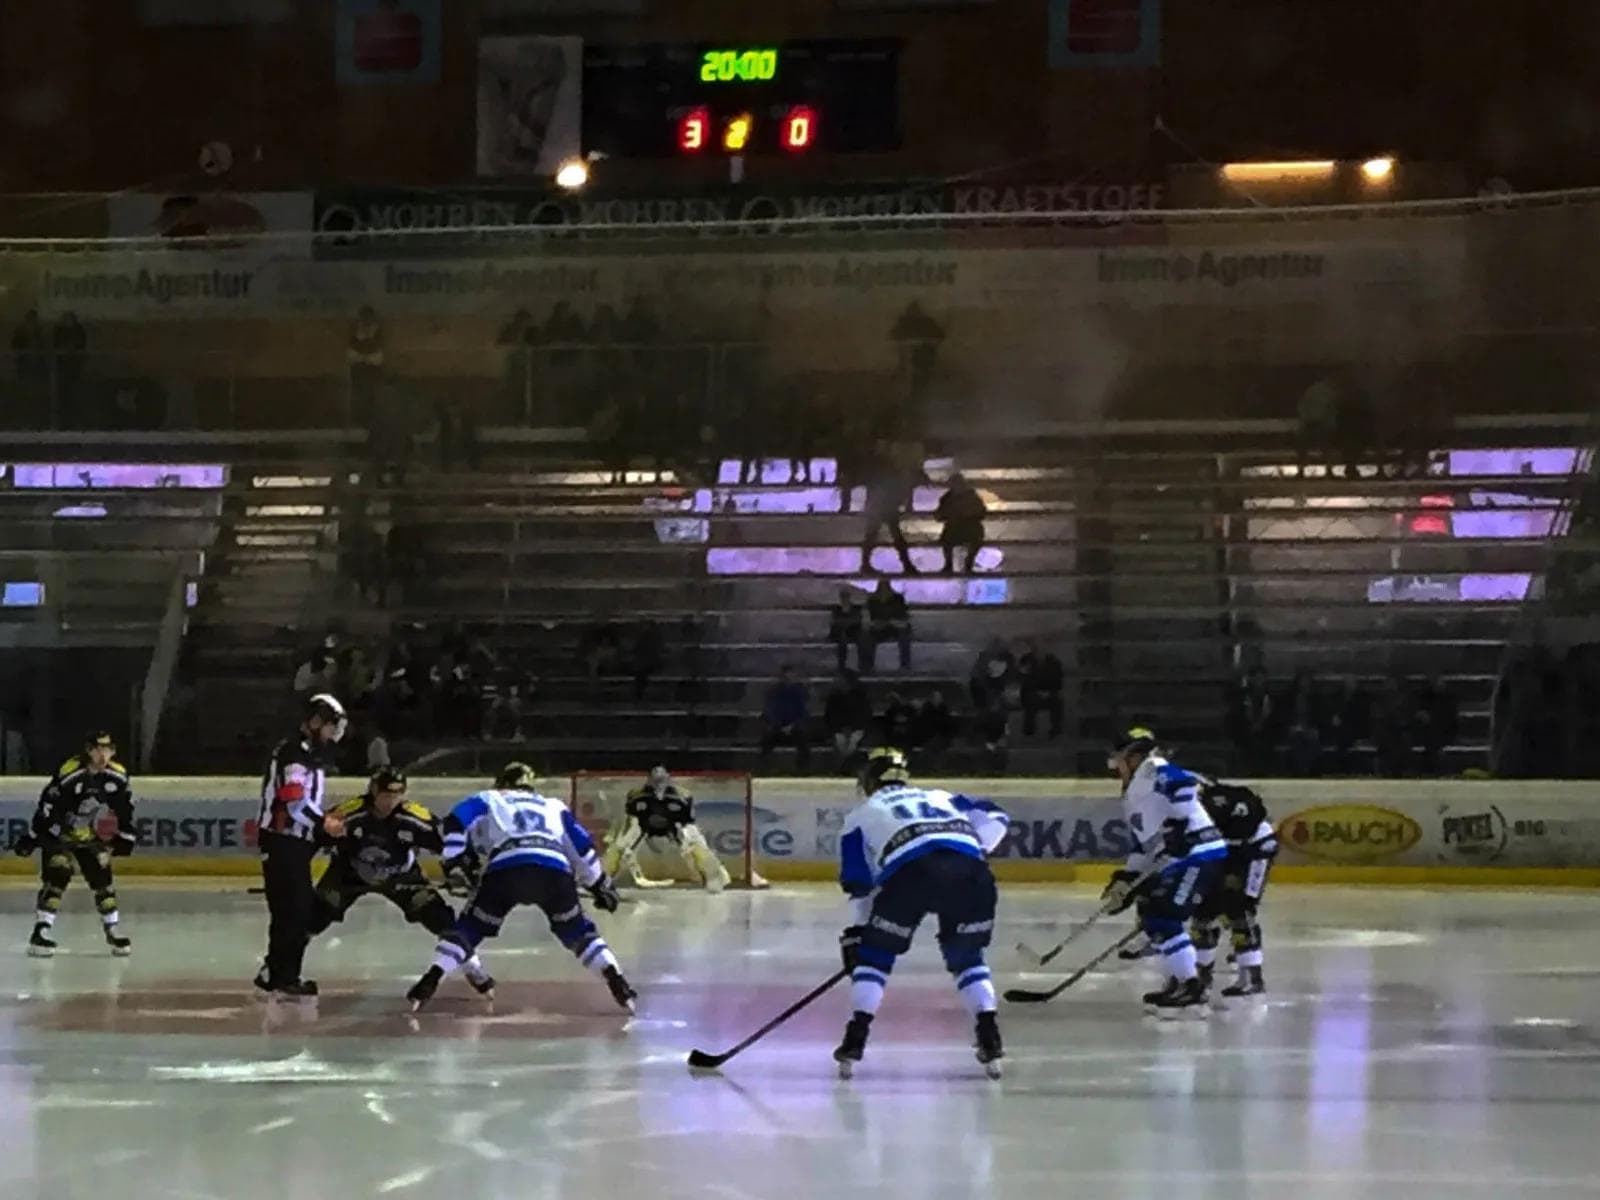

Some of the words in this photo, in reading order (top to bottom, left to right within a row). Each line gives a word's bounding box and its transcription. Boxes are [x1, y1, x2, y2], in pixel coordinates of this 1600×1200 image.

[682, 119, 702, 148] 3
[788, 117, 809, 147] 0
[136, 818, 237, 847] ERSTE
[1313, 820, 1404, 845] RAUCH
